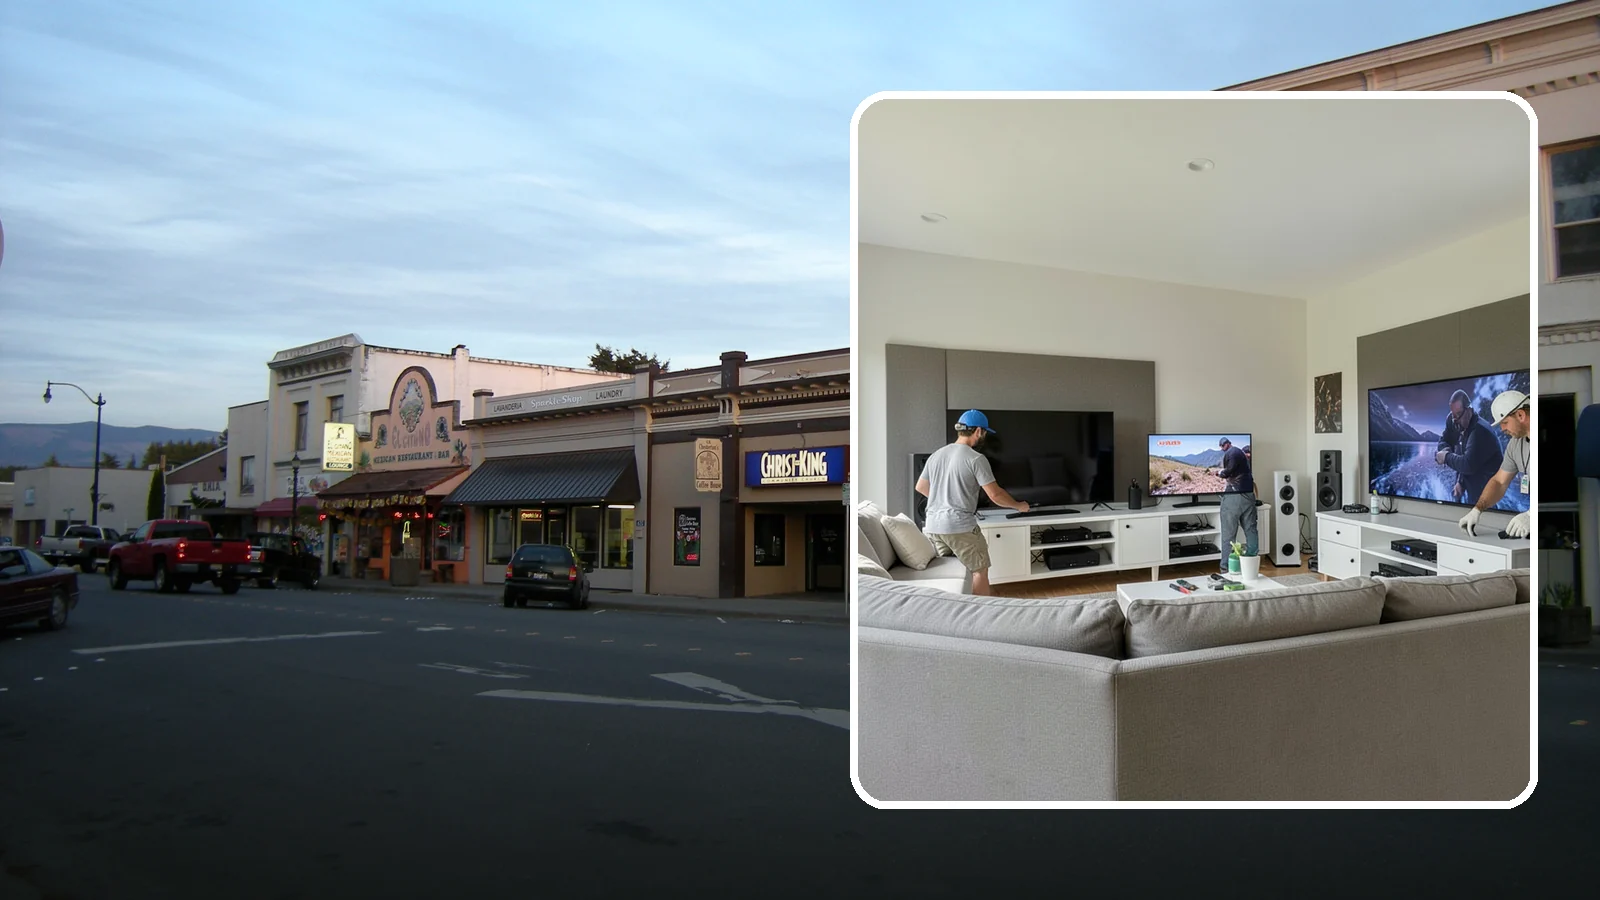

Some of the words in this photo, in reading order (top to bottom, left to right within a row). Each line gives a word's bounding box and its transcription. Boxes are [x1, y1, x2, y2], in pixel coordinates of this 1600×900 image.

[531, 398, 560, 408] Sparkle
[562, 394, 582, 405] Shop
[595, 389, 623, 399] LAUNDRY
[493, 402, 522, 412] LAVANDERIA
[392, 425, 400, 449] EL
[374, 454, 397, 464] MEXICAN
[398, 451, 433, 462] RESTAURANT
[438, 450, 450, 459] BAR
[761, 452, 797, 478] CHRIST
[799, 450, 827, 476] KING
[696, 480, 709, 489] Coffee
[710, 480, 722, 489] House
